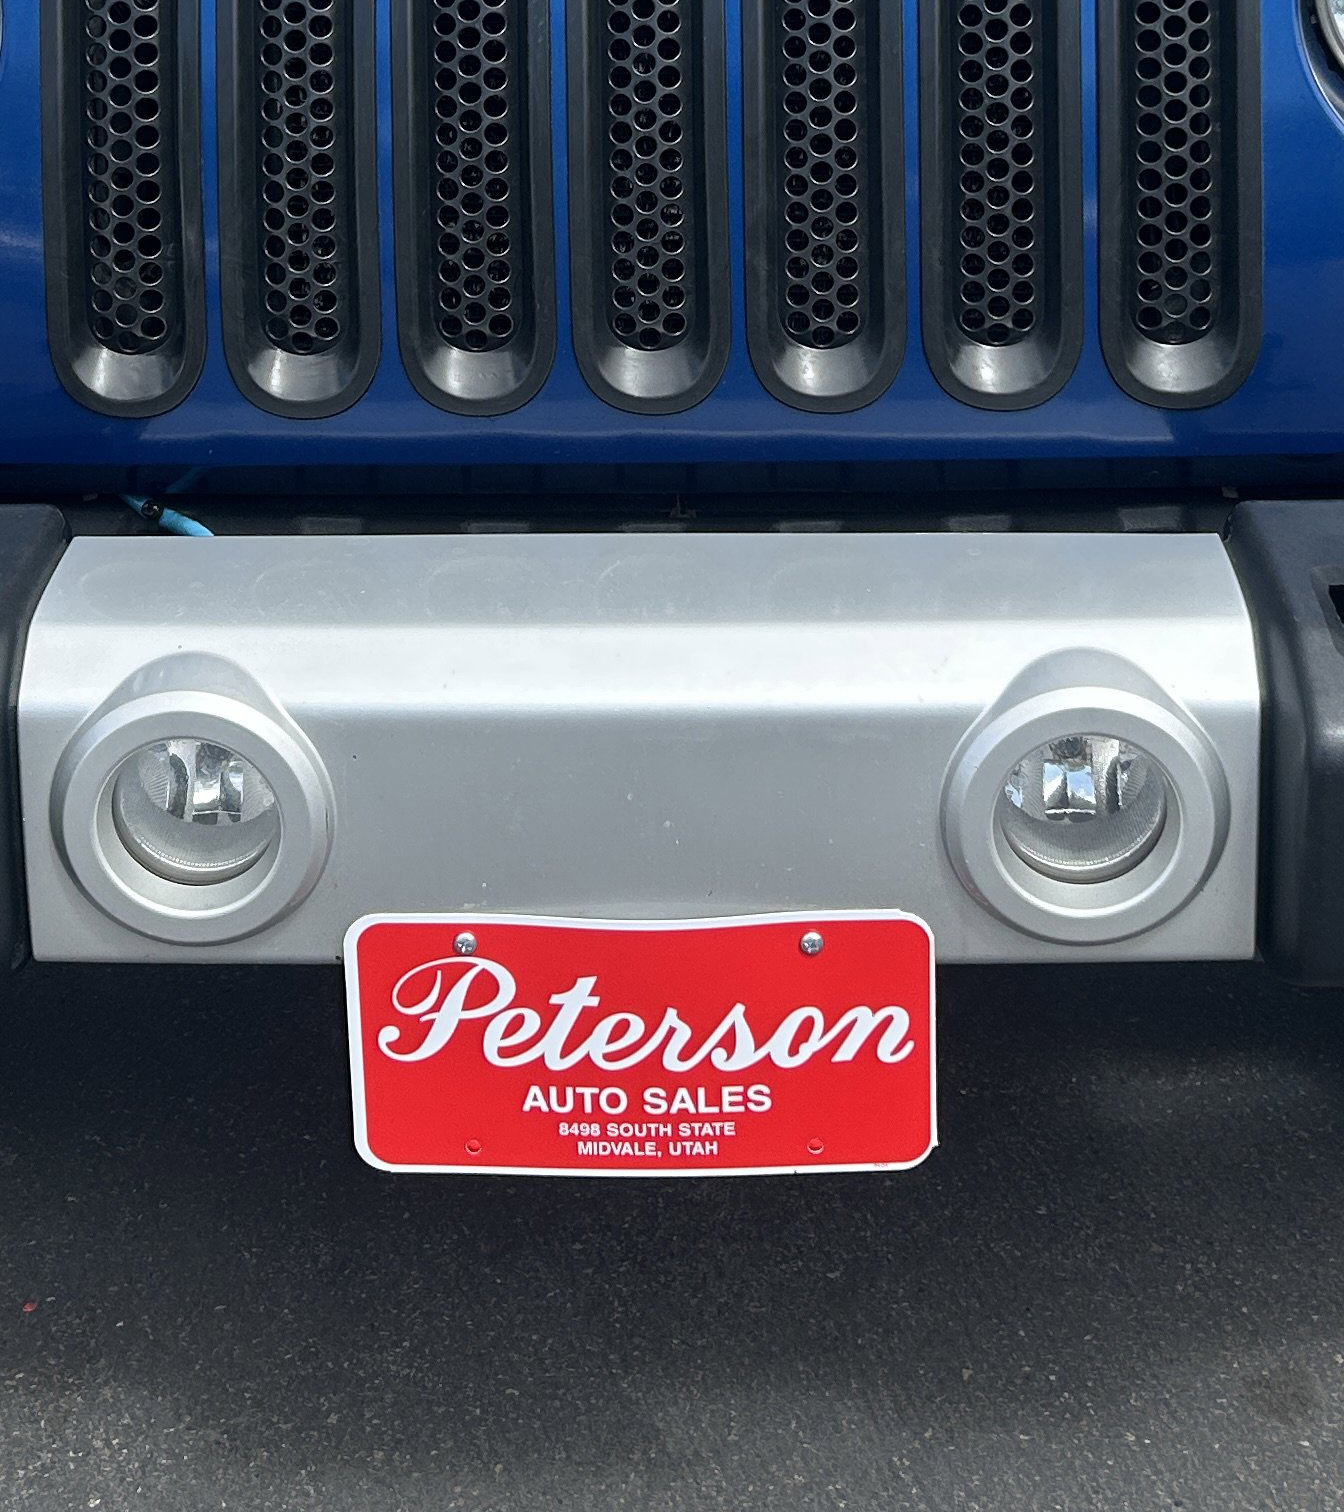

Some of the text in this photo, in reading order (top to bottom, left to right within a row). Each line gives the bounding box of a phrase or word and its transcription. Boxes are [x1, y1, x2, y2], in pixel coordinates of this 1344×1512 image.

[377, 955, 915, 1072] Peterson
[522, 1084, 773, 1115] AUTO SALES
[558, 1121, 736, 1138] 8498 SOUTH STATE
[577, 1140, 719, 1158] MIDVALE, UTAH
